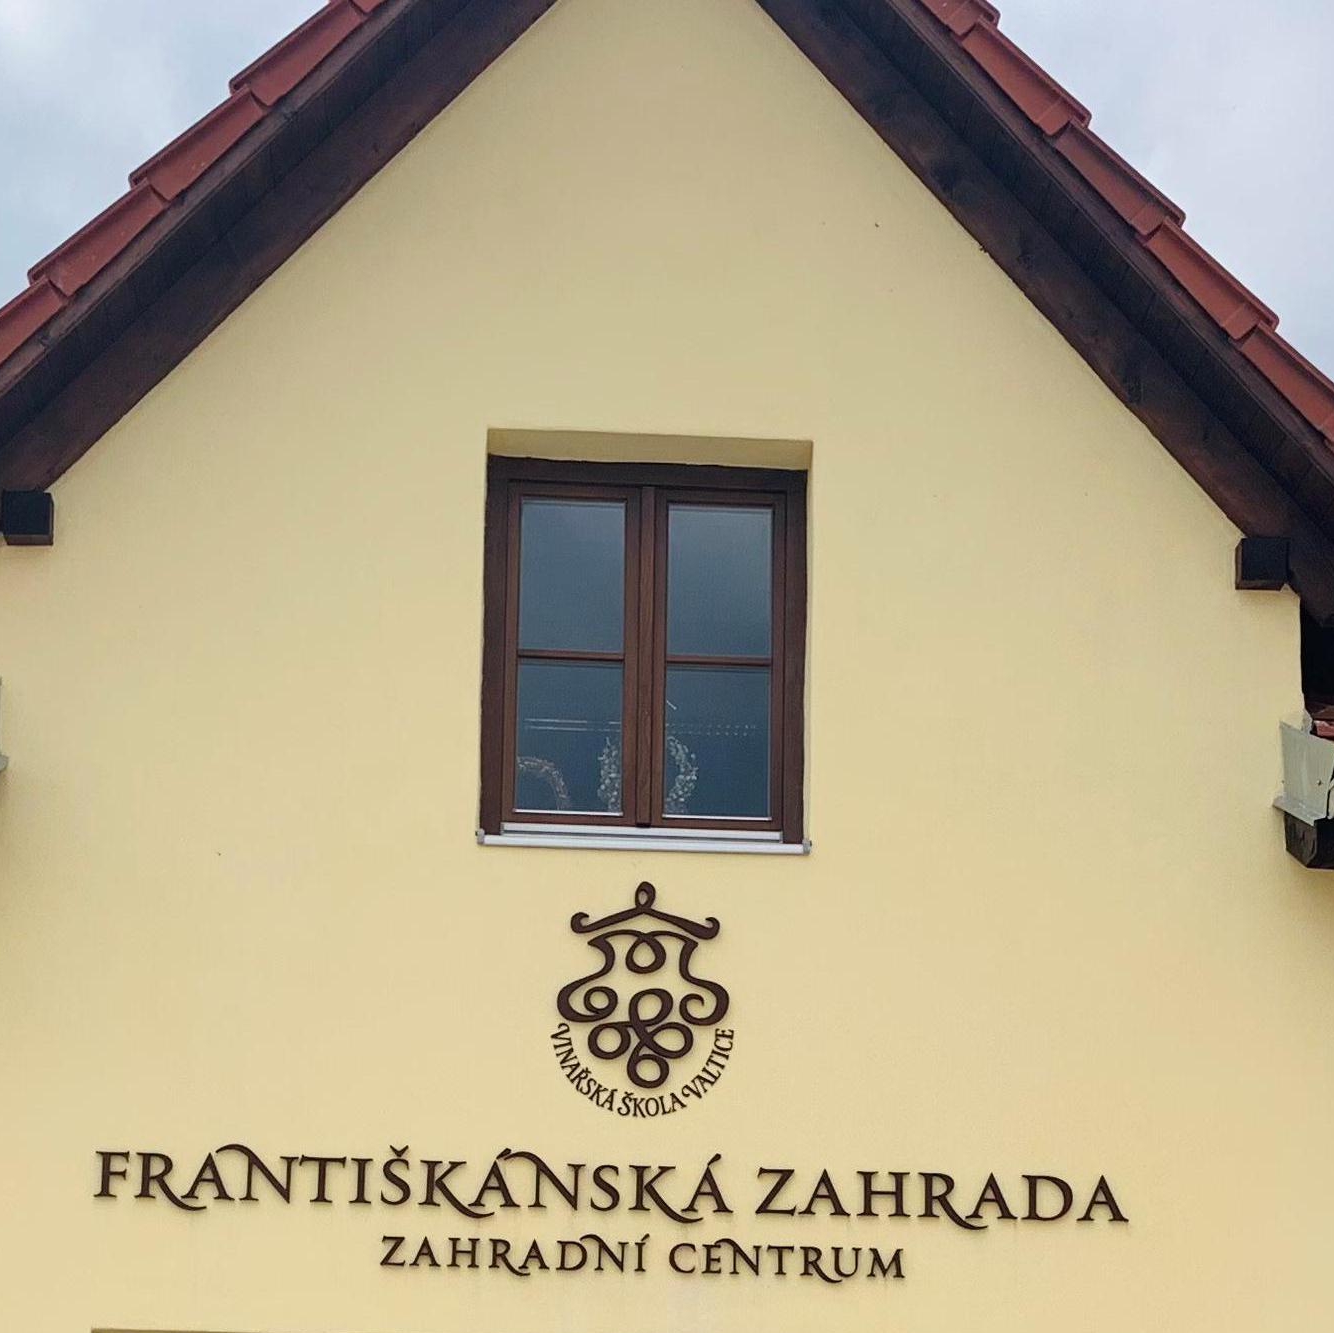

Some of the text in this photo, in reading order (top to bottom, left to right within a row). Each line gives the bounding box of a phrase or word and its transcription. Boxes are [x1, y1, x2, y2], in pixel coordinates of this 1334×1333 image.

[551, 1023, 734, 1118] VINAŘSKÁ ŠKOLA VALTICE
[93, 1143, 1130, 1231] FRANTIŠKÁNSKÁ ZAHRADA
[379, 1232, 905, 1284] ZAHRADNÍ CENTRUM
